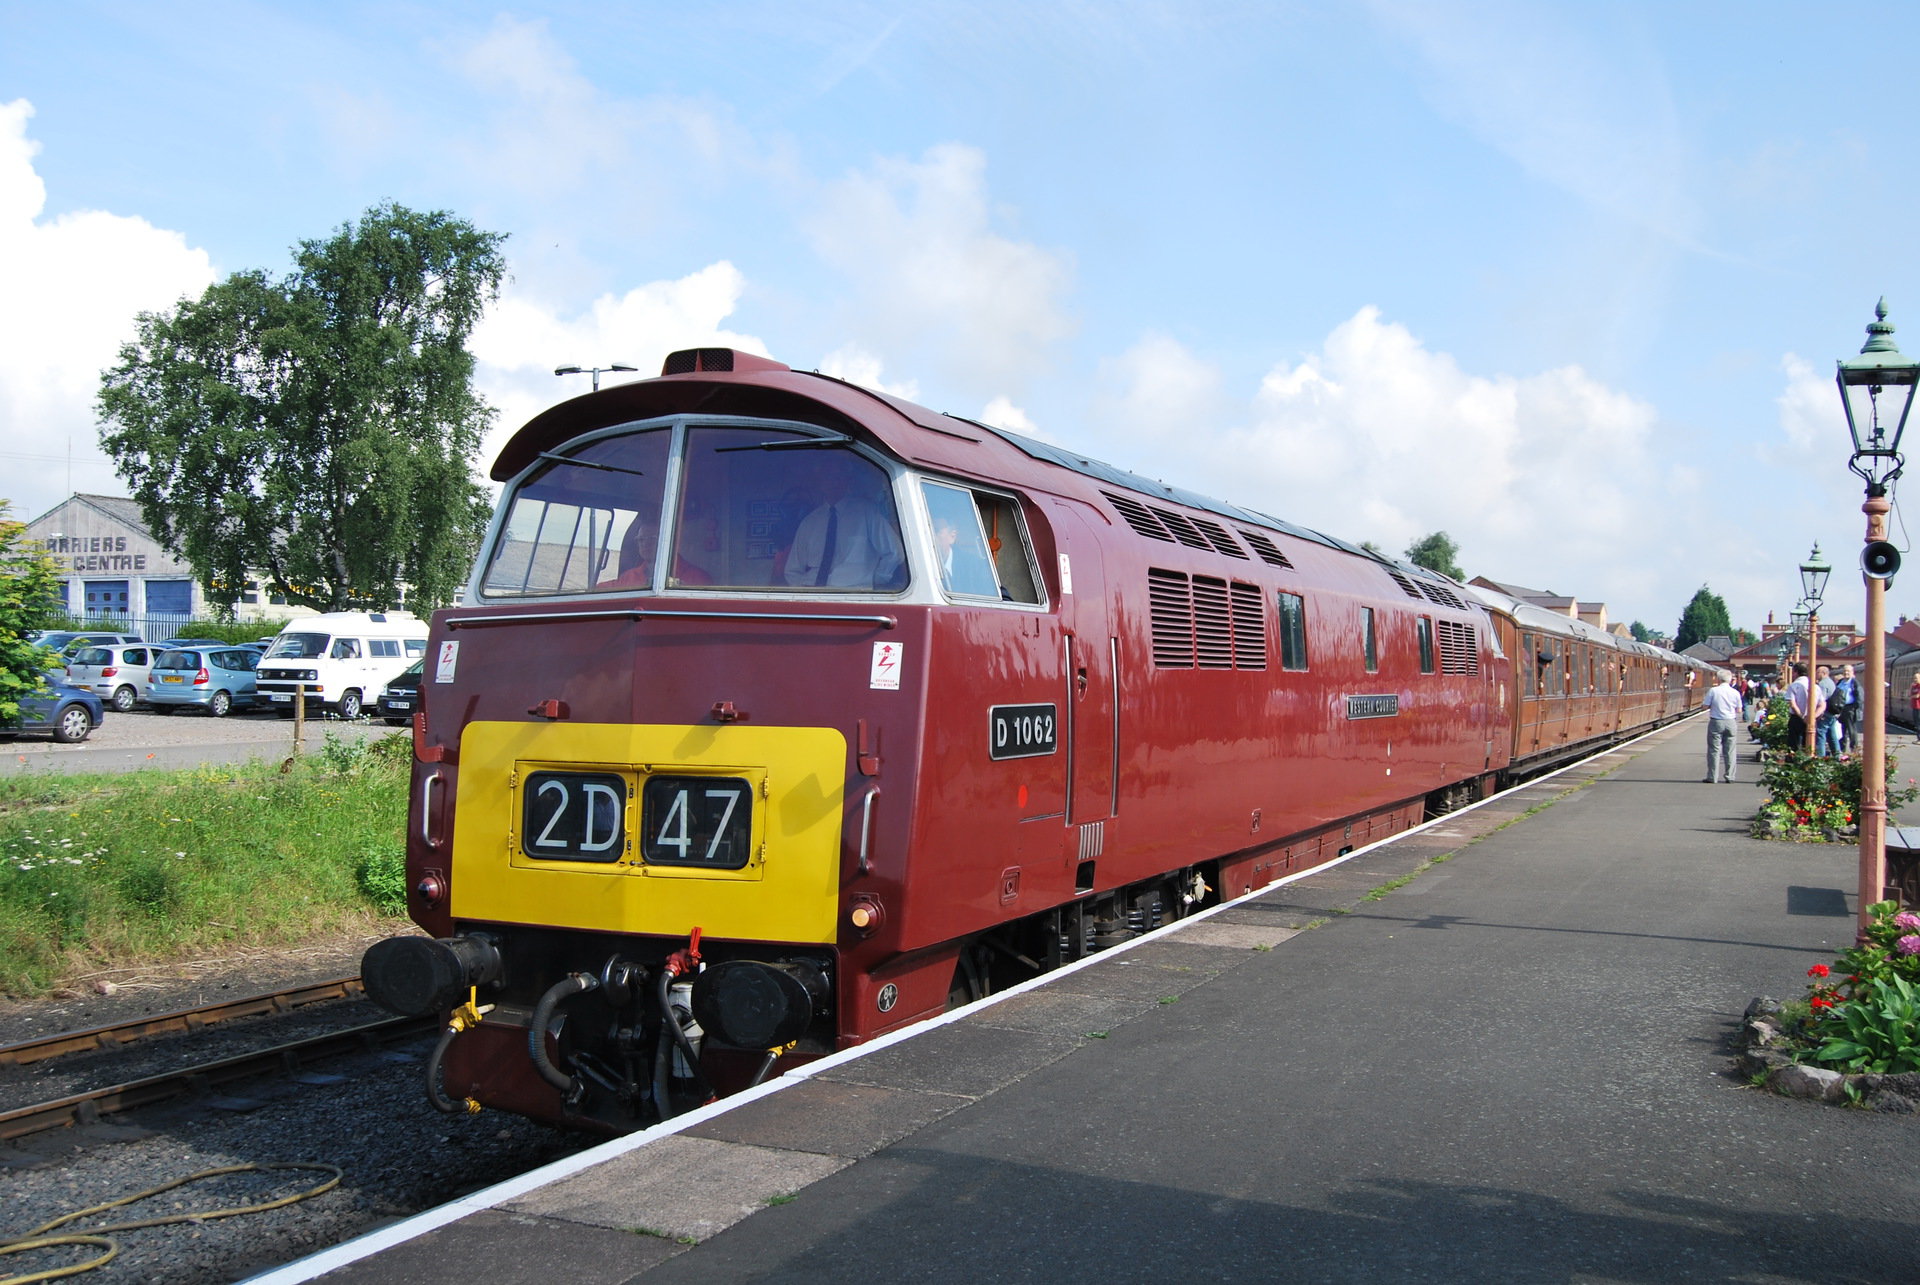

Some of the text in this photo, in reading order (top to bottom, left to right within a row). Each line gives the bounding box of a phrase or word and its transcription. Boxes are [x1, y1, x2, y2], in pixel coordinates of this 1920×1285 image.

[74, 555, 146, 570] CENTRE
[997, 715, 1053, 747] D 1062
[535, 780, 741, 859] 2D 47
[883, 986, 892, 1000] 84
